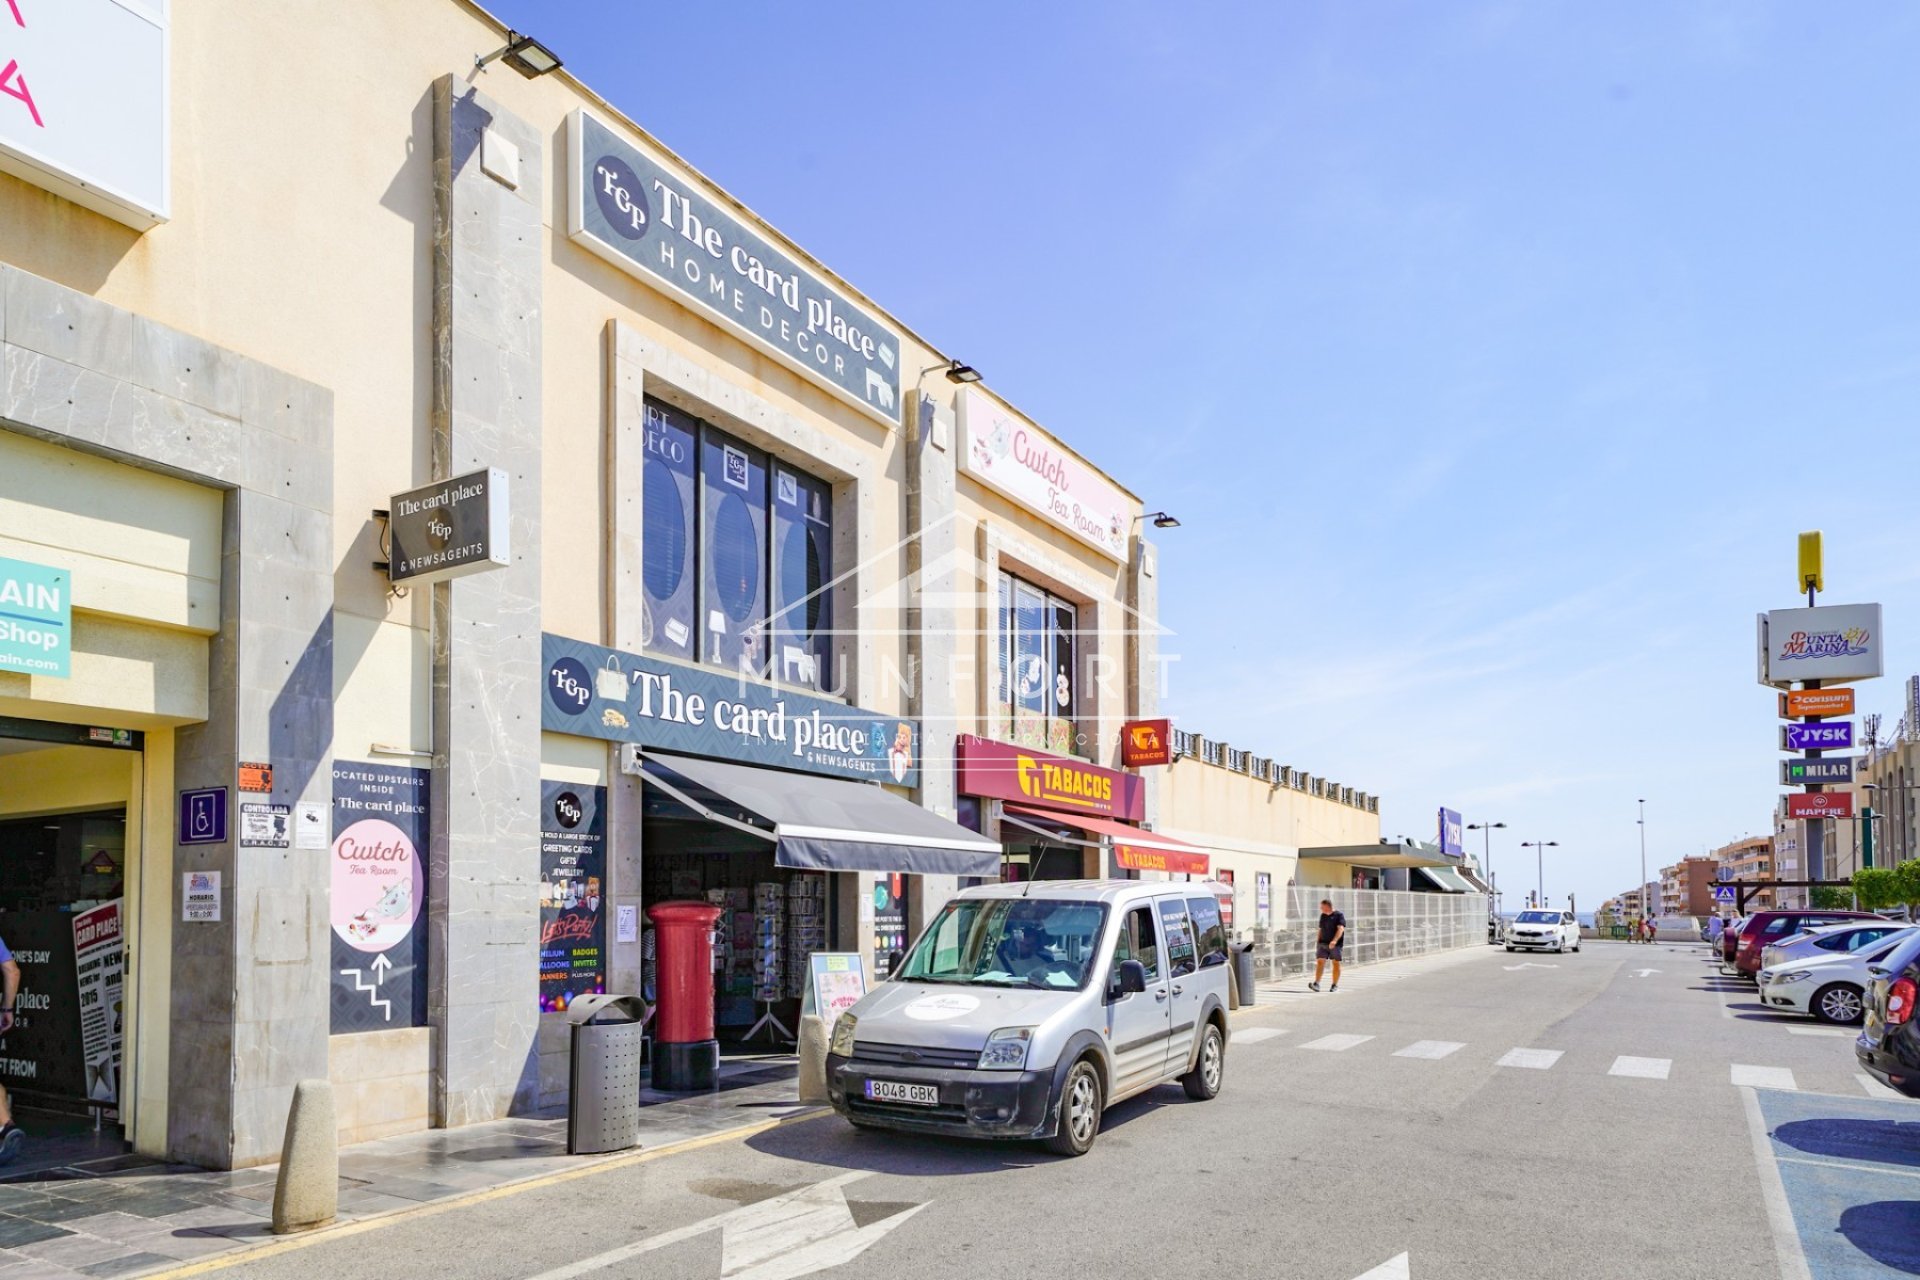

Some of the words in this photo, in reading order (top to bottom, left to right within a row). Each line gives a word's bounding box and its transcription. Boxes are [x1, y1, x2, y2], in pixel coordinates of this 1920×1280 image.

[653, 178, 723, 259] The
[730, 245, 800, 312] card
[806, 297, 875, 361] place
[660, 241, 744, 312] HOME
[760, 306, 845, 376] DECOR
[398, 499, 420, 516] The
[422, 489, 449, 510] card
[451, 483, 483, 507] place
[1048, 487, 1070, 520] Tea
[1073, 503, 1106, 542] Room
[400, 561, 406, 572] &
[409, 543, 483, 570] NEWSAGENTS
[0, 620, 59, 651] Shop
[1791, 631, 1843, 645] PUNTA
[1781, 639, 1849, 656] MARINA
[1802, 694, 1850, 704] consum
[632, 669, 706, 727] The
[713, 700, 787, 742] card
[792, 708, 865, 756] place
[1801, 728, 1848, 741] JYSK
[815, 754, 876, 773] NEWSAGENTS
[1130, 752, 1164, 760] TABACOS
[1806, 764, 1848, 776] MILAR
[377, 774, 424, 786] UPSTAIRS
[1042, 763, 1111, 801] TABACOS
[360, 784, 394, 794] INSIDE
[243, 804, 288, 814] CONTROLADA
[338, 797, 363, 809] The
[365, 801, 392, 812] card
[394, 802, 425, 815] place
[1795, 807, 1846, 816] MAPFRE
[543, 844, 572, 853] GREETING
[573, 845, 592, 854] CARDS
[560, 856, 576, 865] GIFTS
[1135, 853, 1166, 869] TABACOS
[350, 864, 367, 875] Tea
[370, 865, 398, 876] Room
[552, 868, 584, 876] JEWELLERY
[77, 925, 95, 946] CARD
[96, 916, 117, 938] PLACE
[34, 951, 50, 964] DAY
[572, 948, 598, 956] BADGES
[573, 959, 597, 967] INVITES
[16, 987, 50, 1014] place
[9, 1060, 36, 1078] FROM
[873, 1082, 906, 1098] 8048
[910, 1086, 935, 1101] GBK
